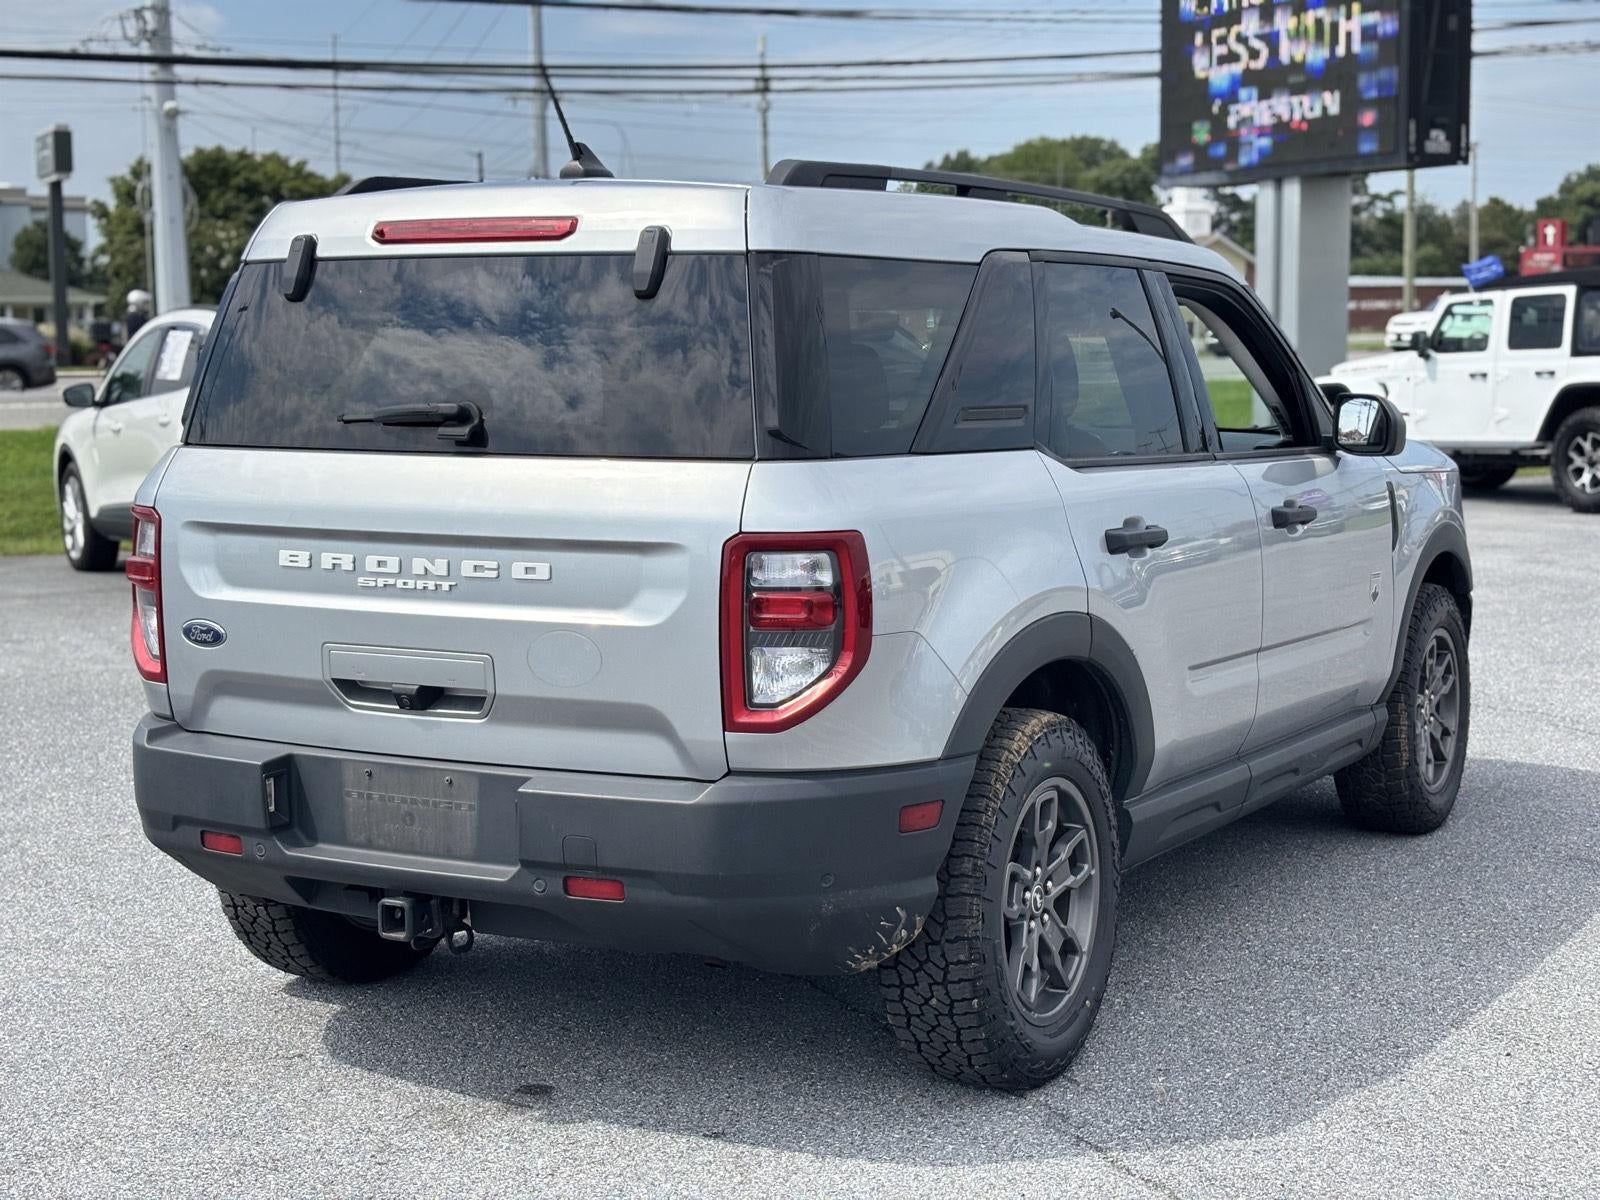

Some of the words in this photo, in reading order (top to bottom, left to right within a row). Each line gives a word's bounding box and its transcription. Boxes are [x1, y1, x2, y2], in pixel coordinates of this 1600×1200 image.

[1192, 23, 1269, 79] LESS
[278, 549, 553, 581] BRONCO
[357, 576, 457, 592] SPORT
[190, 625, 214, 642] Ford
